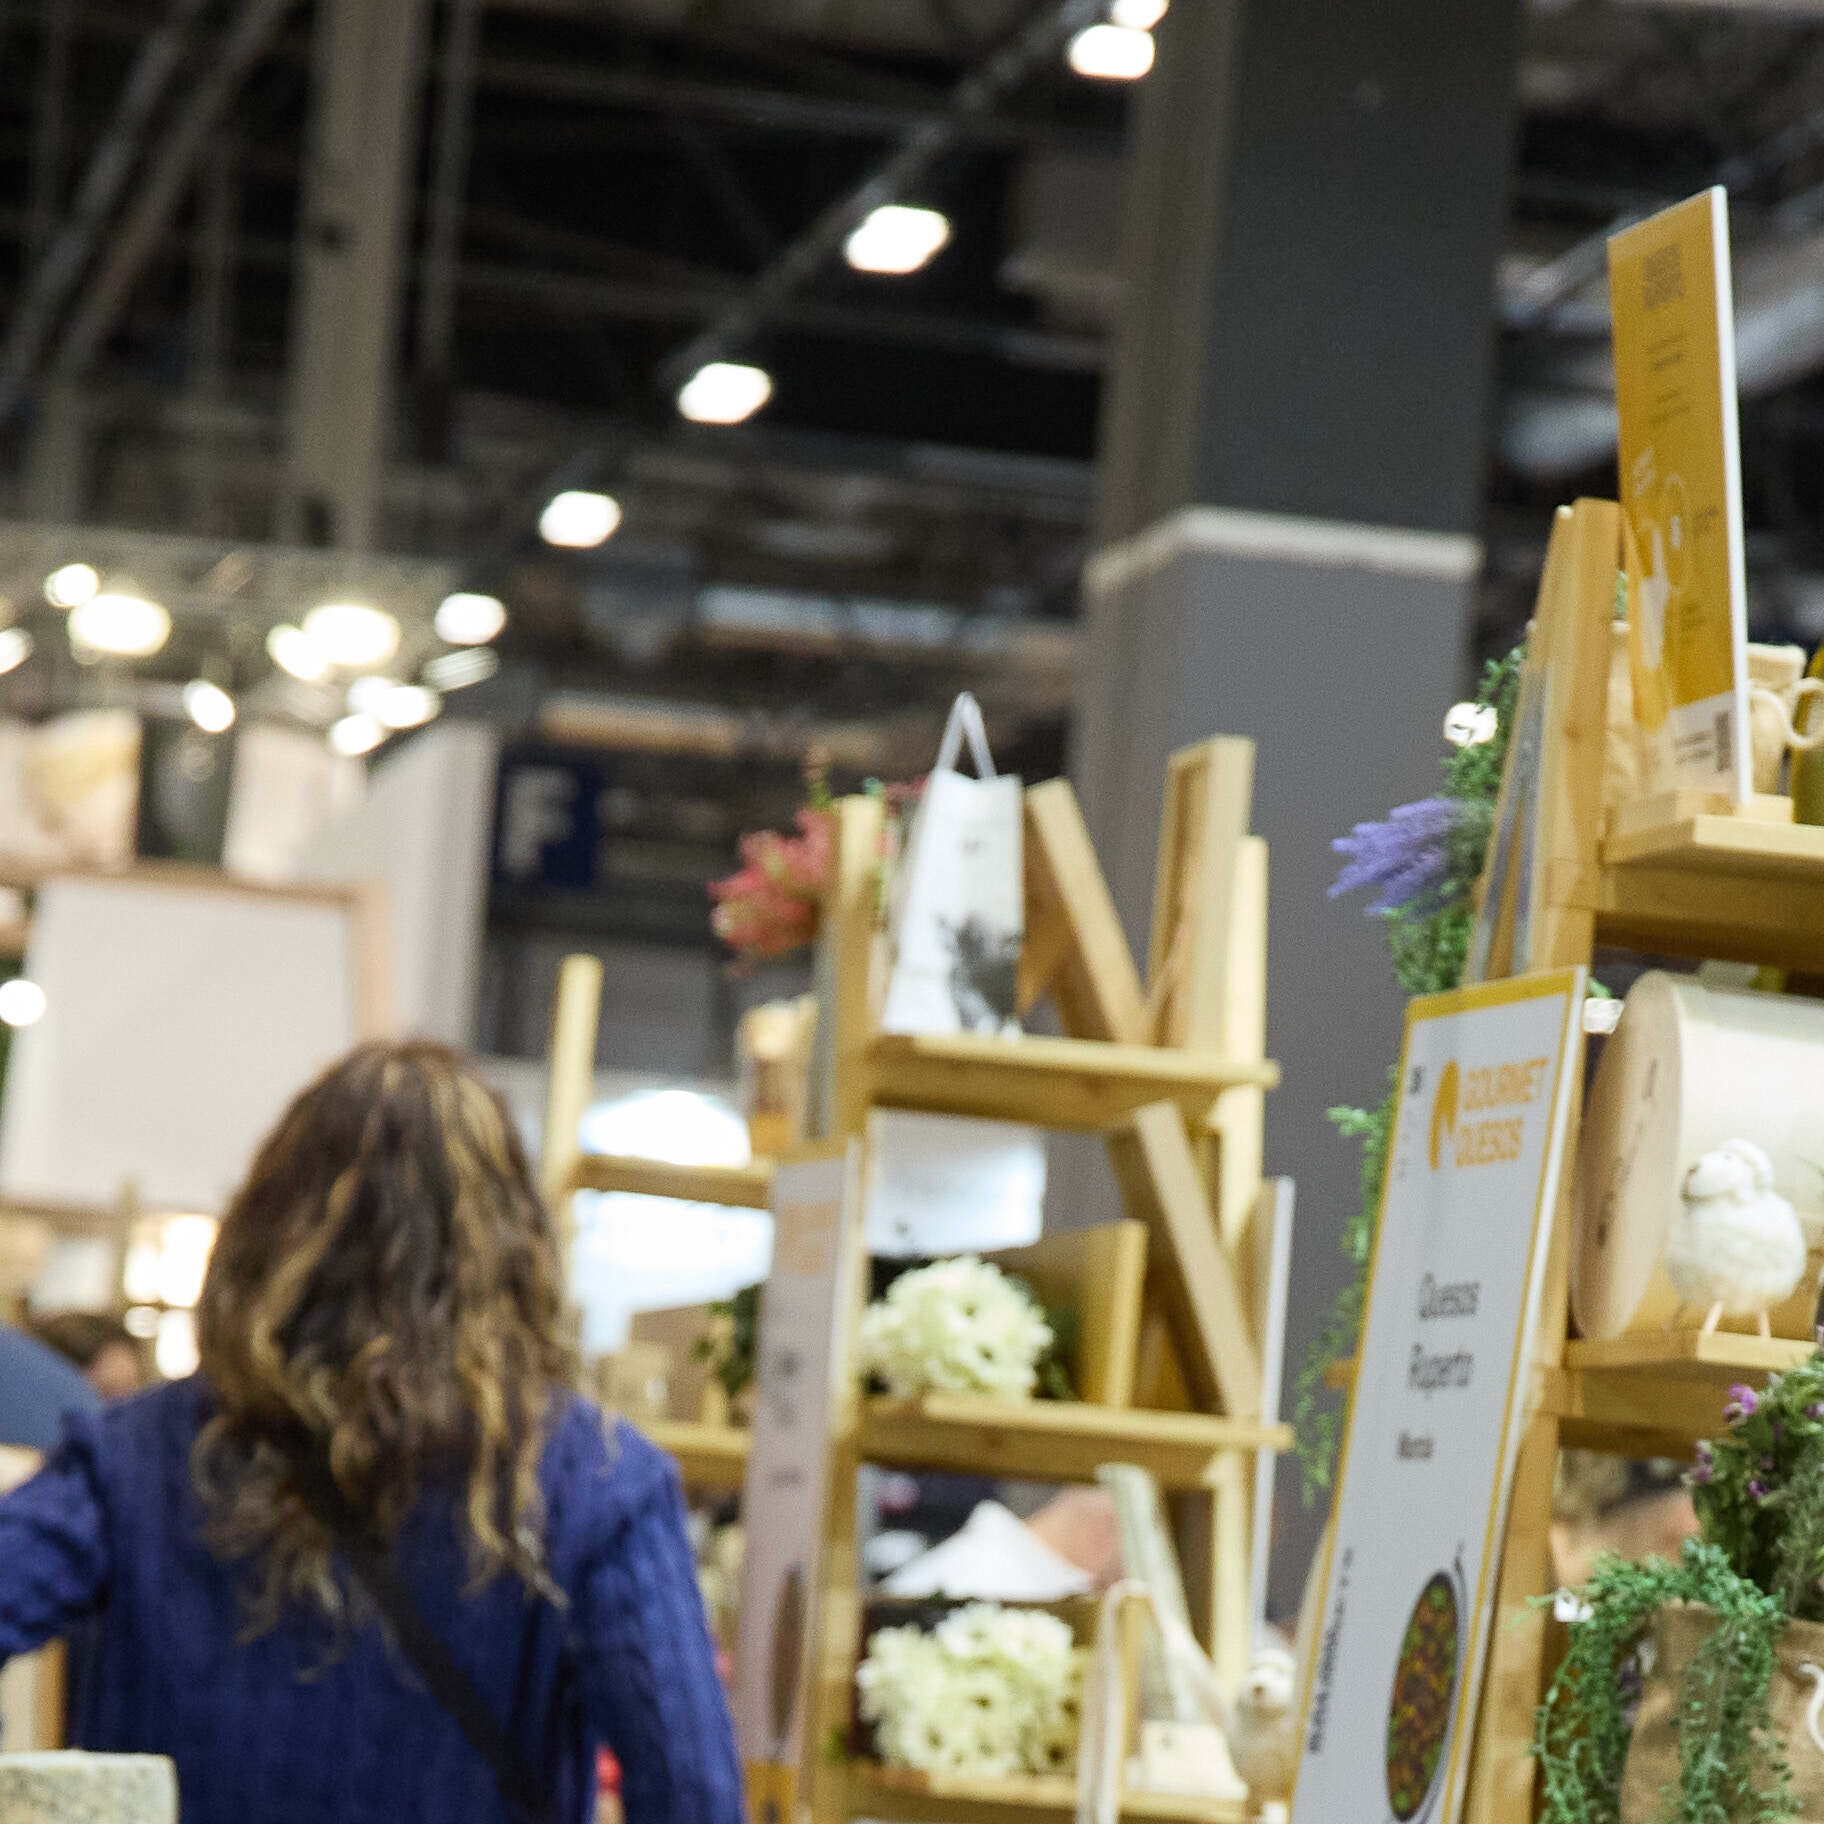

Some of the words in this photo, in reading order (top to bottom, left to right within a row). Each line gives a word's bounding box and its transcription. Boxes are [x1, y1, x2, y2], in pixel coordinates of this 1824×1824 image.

[503, 767, 577, 875] F
[1463, 1057, 1549, 1112] GOURMET
[1455, 1117, 1524, 1168] QUESOS
[1419, 1272, 1480, 1320] Quesos
